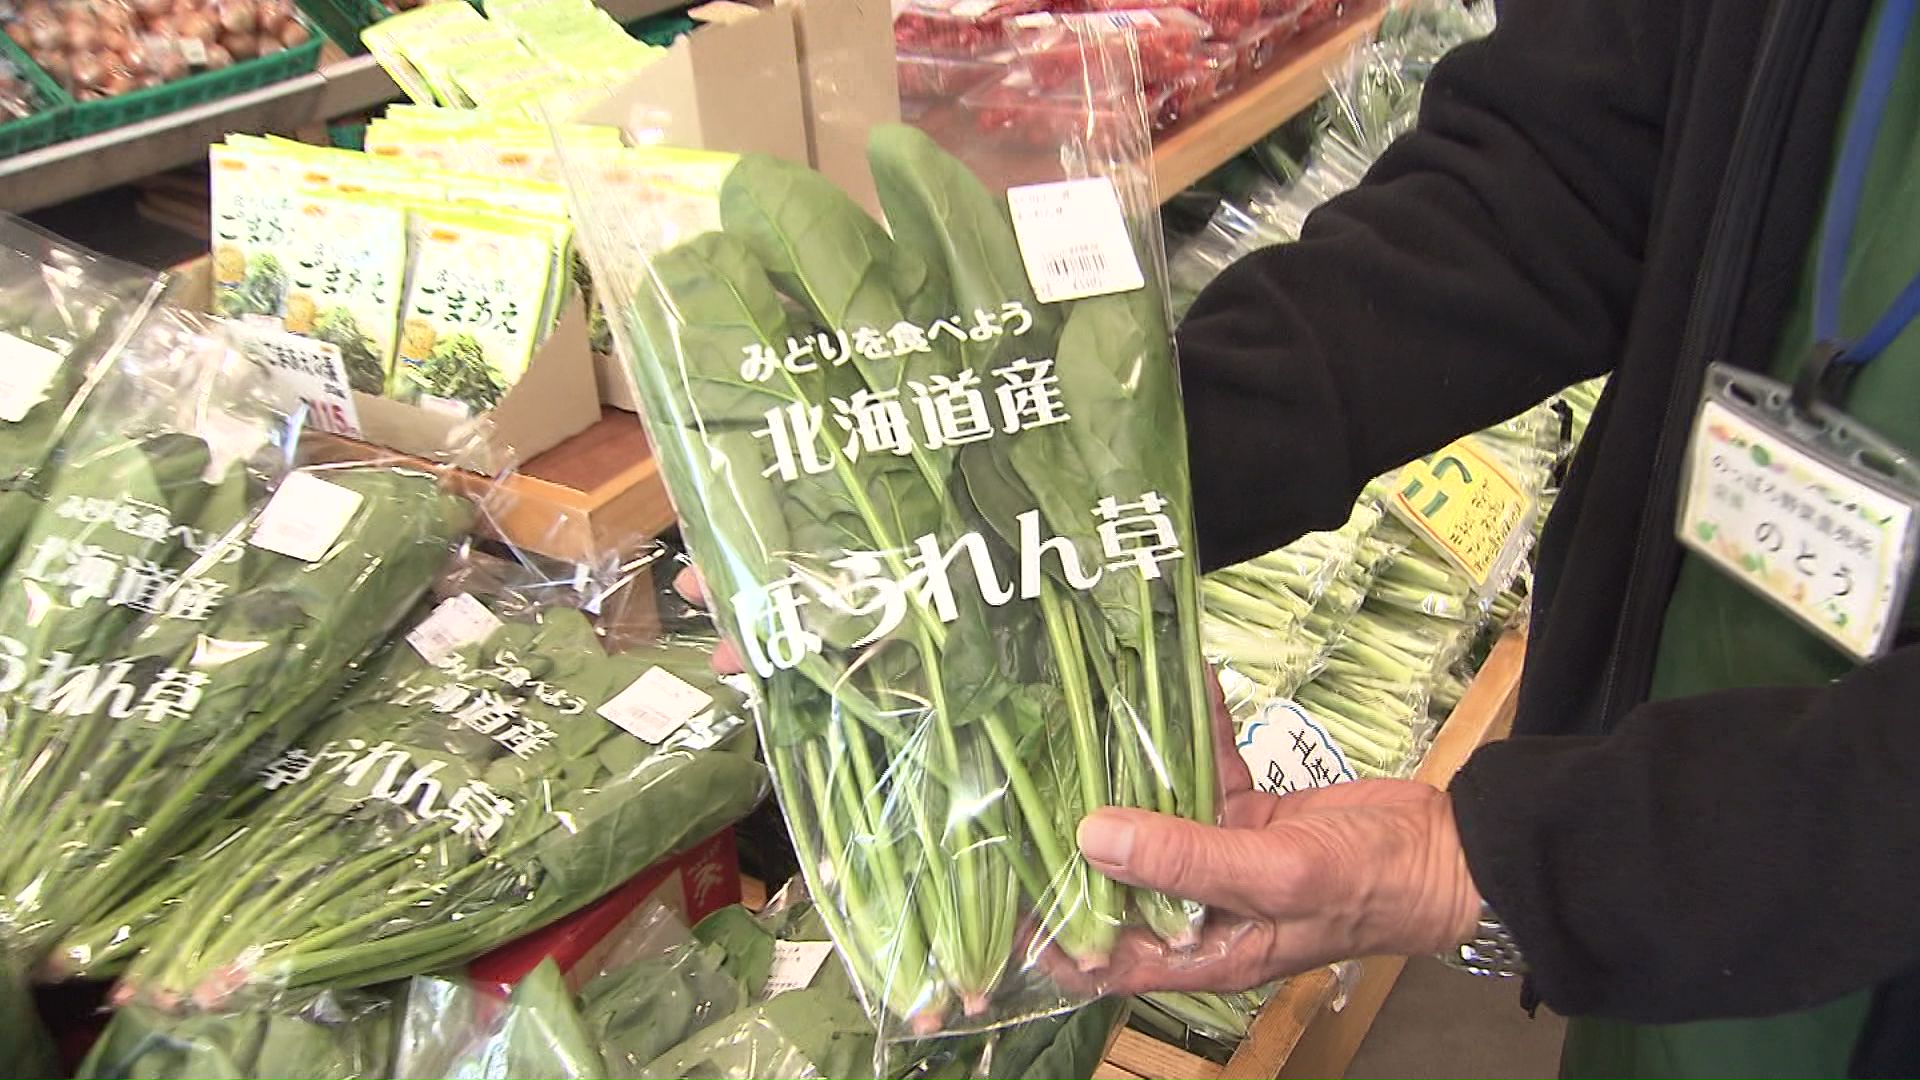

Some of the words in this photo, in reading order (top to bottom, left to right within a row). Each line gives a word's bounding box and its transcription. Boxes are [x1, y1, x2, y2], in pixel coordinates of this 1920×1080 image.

[415, 283, 519, 335] ごまあえ
[740, 301, 1034, 383] みどりを食べよう
[751, 357, 1072, 483] 北海道産
[730, 490, 1185, 680] ほうれん草
[1754, 521, 1854, 597] のとう
